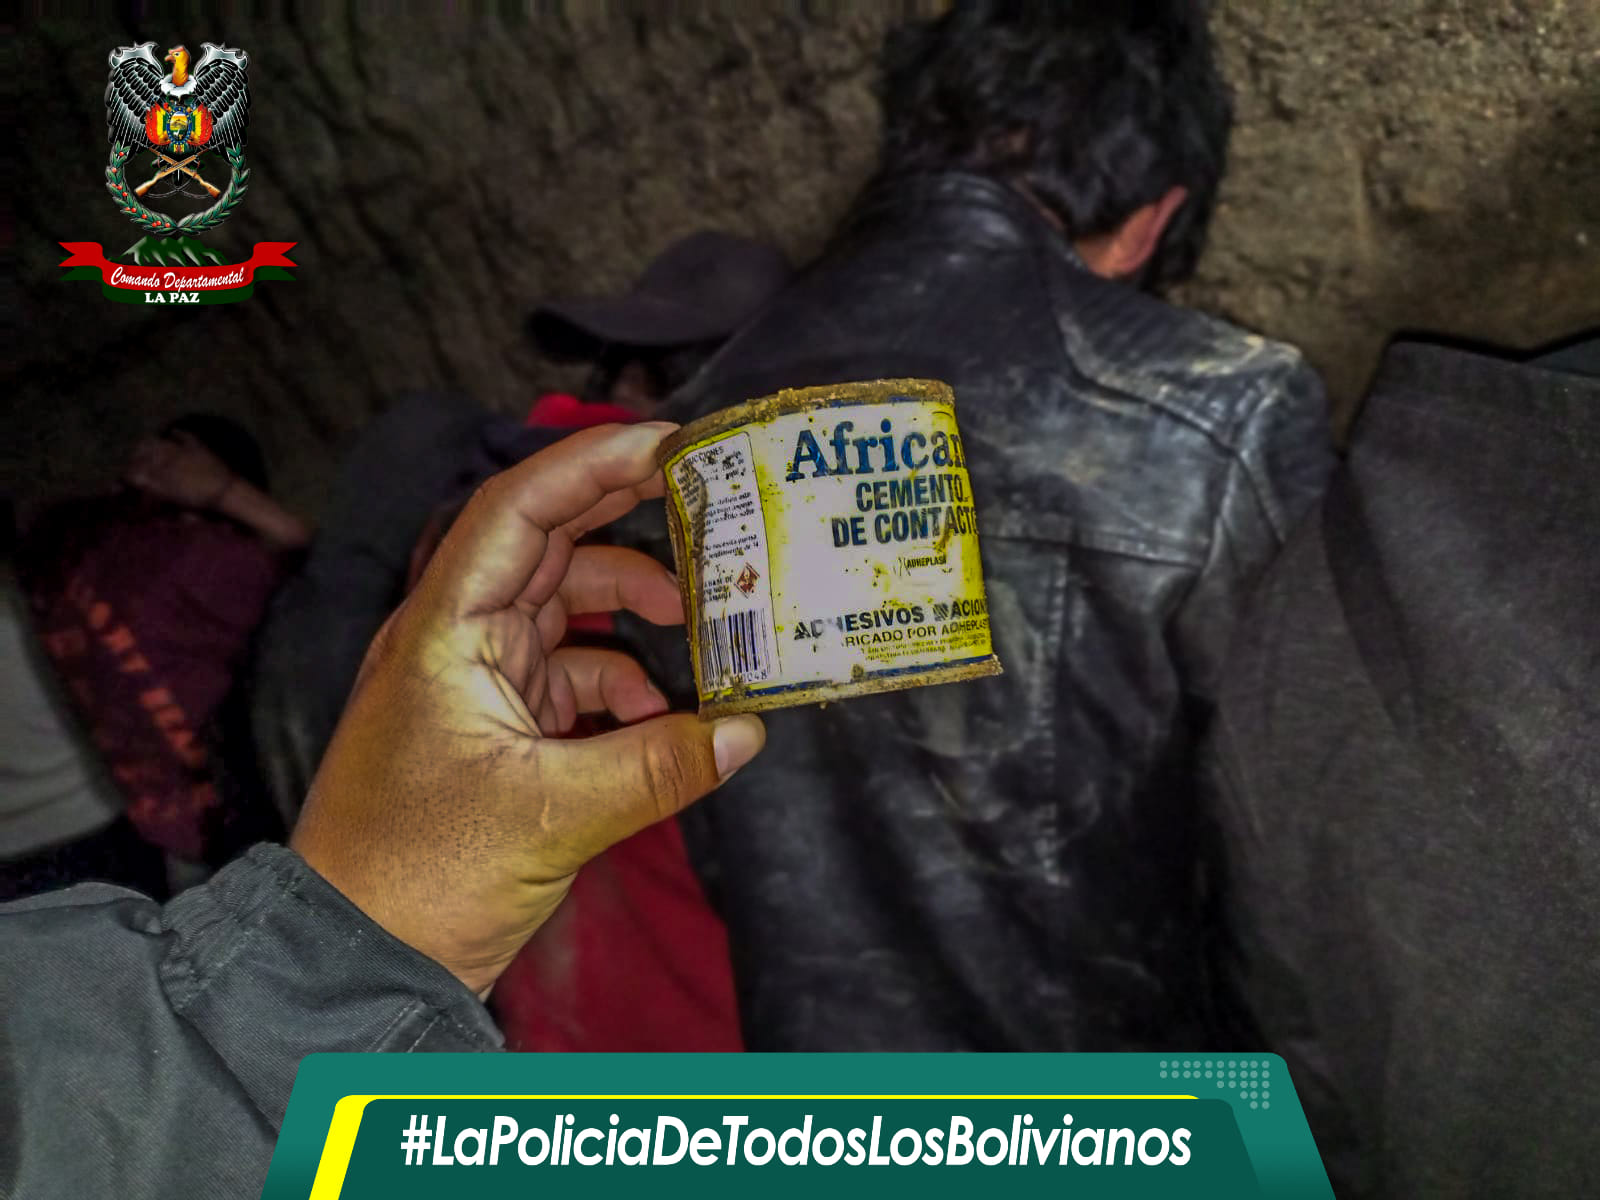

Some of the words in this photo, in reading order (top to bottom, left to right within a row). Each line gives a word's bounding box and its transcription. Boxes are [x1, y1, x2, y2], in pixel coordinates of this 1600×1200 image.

[855, 473, 964, 512] CEMENTO
[831, 516, 868, 548] DE
[907, 625, 937, 642] POR
